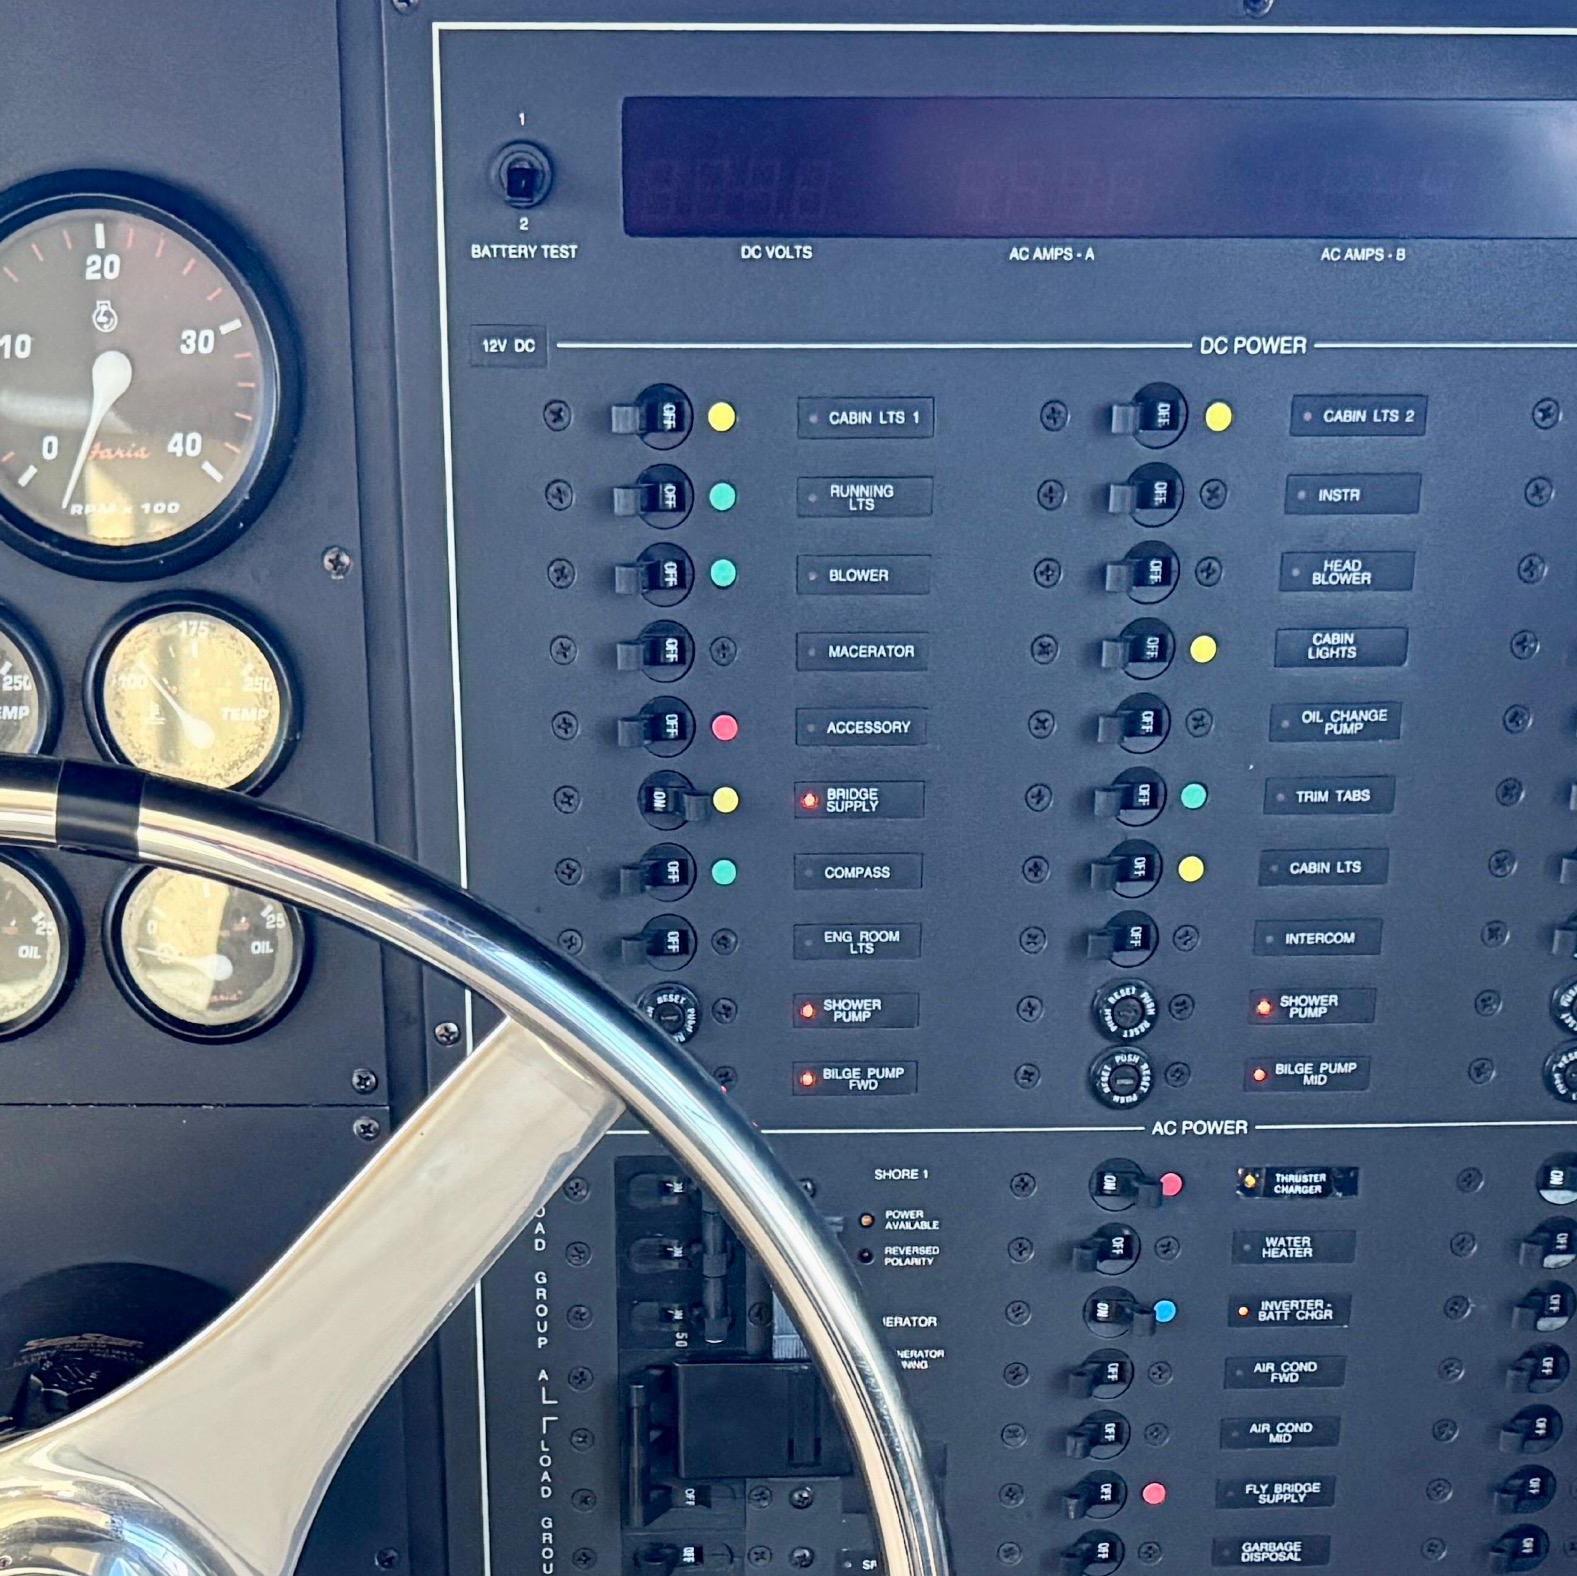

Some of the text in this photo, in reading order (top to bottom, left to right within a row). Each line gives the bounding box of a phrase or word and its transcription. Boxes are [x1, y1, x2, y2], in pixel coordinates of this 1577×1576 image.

[472, 244, 577, 258] BATTERY TEST
[741, 245, 812, 259] DC VOLTS
[483, 339, 535, 352] 12V DC
[1201, 336, 1306, 354] DC POWER
[829, 411, 918, 424] CABIN LTS 1
[831, 485, 893, 497] RUNNING
[1319, 489, 1360, 501] INSTR
[850, 498, 874, 510] LTS
[830, 569, 888, 581] BLOWER
[829, 645, 914, 658] MACERATOR
[1302, 709, 1387, 723] OIL CHANGE
[827, 721, 910, 734] ACCESSORY
[1325, 722, 1363, 734] PUMP
[828, 788, 878, 800] BRIDGE
[1296, 789, 1370, 802] TRIM TABS
[827, 801, 878, 812] SUPPLY
[825, 866, 890, 878] COMPASS
[1286, 932, 1355, 944] INTERCOM
[1152, 1120, 1247, 1135] AC POWER
[875, 1169, 928, 1180] SHORE 1
[1276, 1173, 1326, 1183] THRUSTER
[1274, 1185, 1321, 1194] CHARGER
[886, 1210, 923, 1219] POWER
[885, 1221, 939, 1230] AVAILABLE
[1266, 1236, 1310, 1247] WATER
[885, 1246, 939, 1255] REVERSED
[1263, 1248, 1312, 1258] HEATER
[885, 1257, 933, 1266] POLARITY
[1242, 1542, 1301, 1552] GARBAGE
[1241, 1552, 1301, 1562] DISPOSAL
